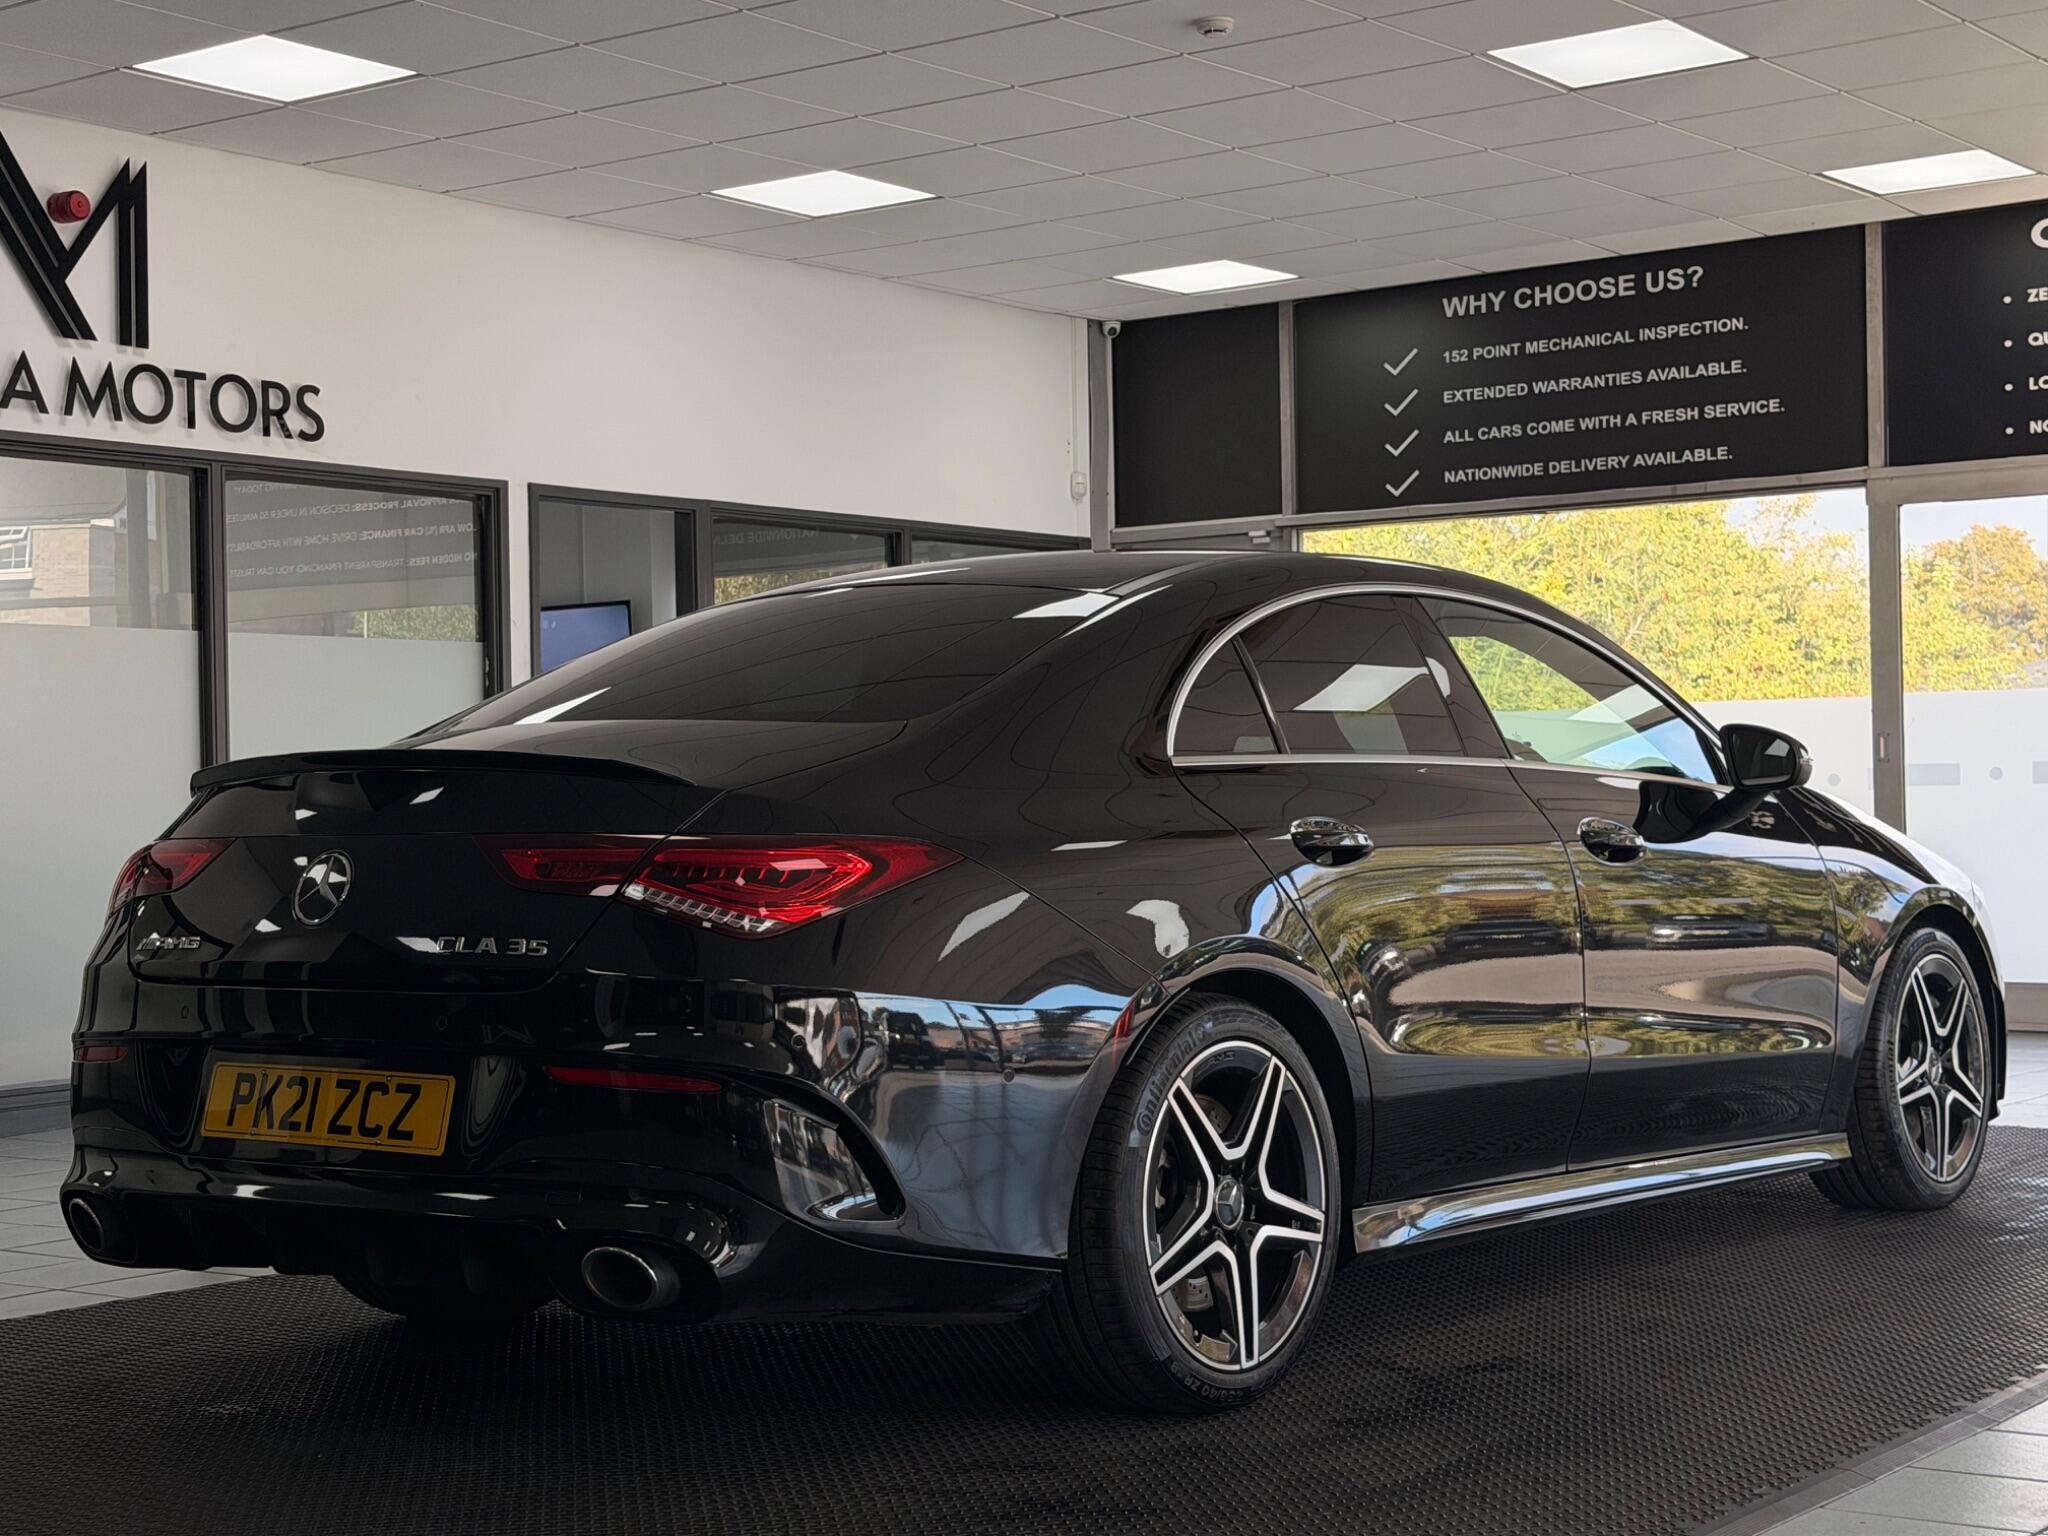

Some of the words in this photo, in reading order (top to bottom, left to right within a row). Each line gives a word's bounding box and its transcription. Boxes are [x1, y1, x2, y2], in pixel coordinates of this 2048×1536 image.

[1442, 290, 1506, 318] WHY
[1513, 274, 1636, 309] CHOOSE
[1646, 265, 1704, 293] US?
[1443, 349, 1468, 363] 152
[1473, 343, 1521, 360] POINT
[1525, 330, 1635, 355] MECHANICAL
[1639, 317, 1749, 342] INSPECTION.
[64, 355, 325, 442] MOTORS
[1443, 383, 1528, 403] EXTENDED
[1532, 371, 1643, 394] WARRANTIES
[1647, 360, 1747, 382] AVAILABLE.
[1443, 429, 1474, 444] ALL
[1478, 424, 1522, 440] CARS
[1526, 419, 1575, 436] COME
[1579, 415, 1621, 430] WITH
[1625, 413, 1638, 426] A
[1642, 407, 1699, 425] FRESH
[1704, 398, 1785, 419] SERVICE.
[1444, 463, 1544, 484] NATIONWIDE
[1549, 455, 1630, 475] DELIVERY
[1633, 446, 1733, 467] AVAILABLE.
[436, 935, 498, 955] CLA
[504, 937, 550, 957] 35
[226, 1071, 323, 1133] PK21
[326, 1079, 424, 1142] ZCZ
